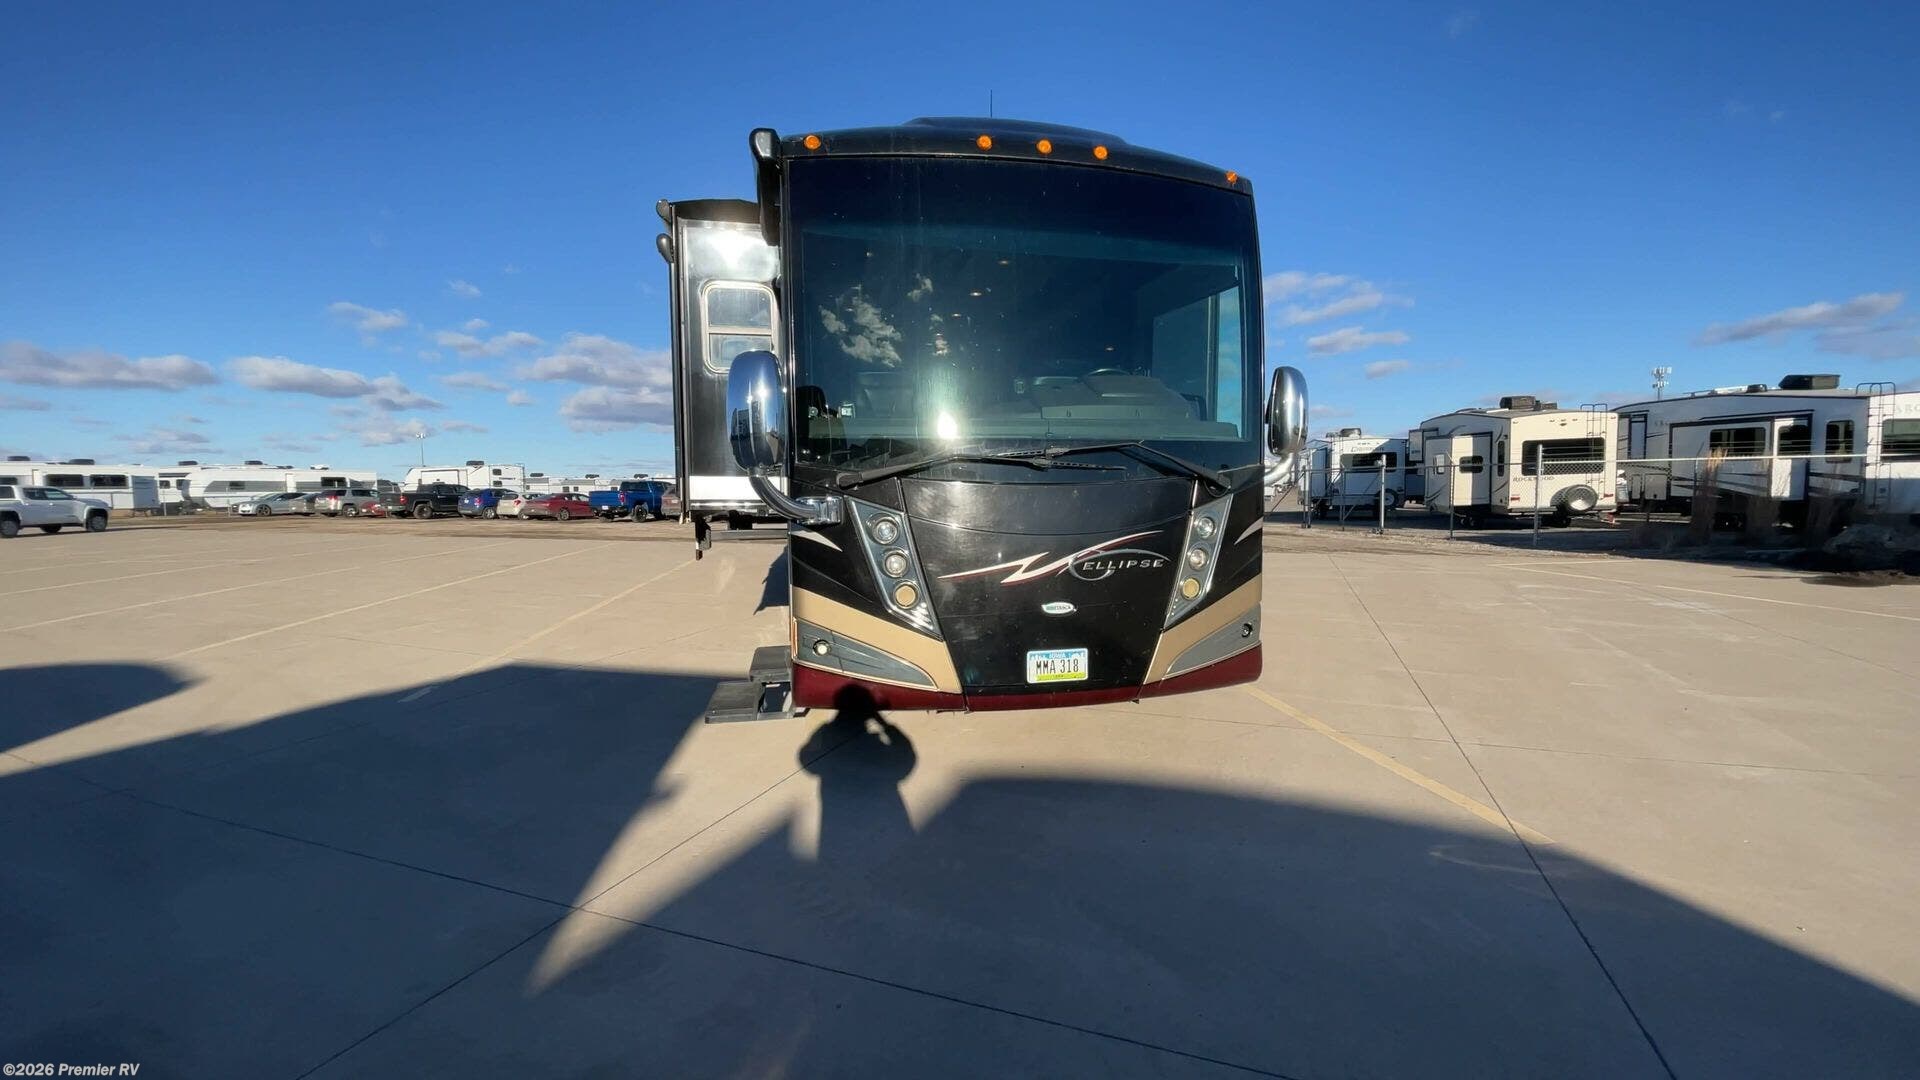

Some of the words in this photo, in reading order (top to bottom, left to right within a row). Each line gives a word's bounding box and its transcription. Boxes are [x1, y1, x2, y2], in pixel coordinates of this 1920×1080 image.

[1082, 559, 1165, 571] ELLIPSE
[1035, 659, 1056, 675] MMA
[1060, 658, 1079, 673] 318
